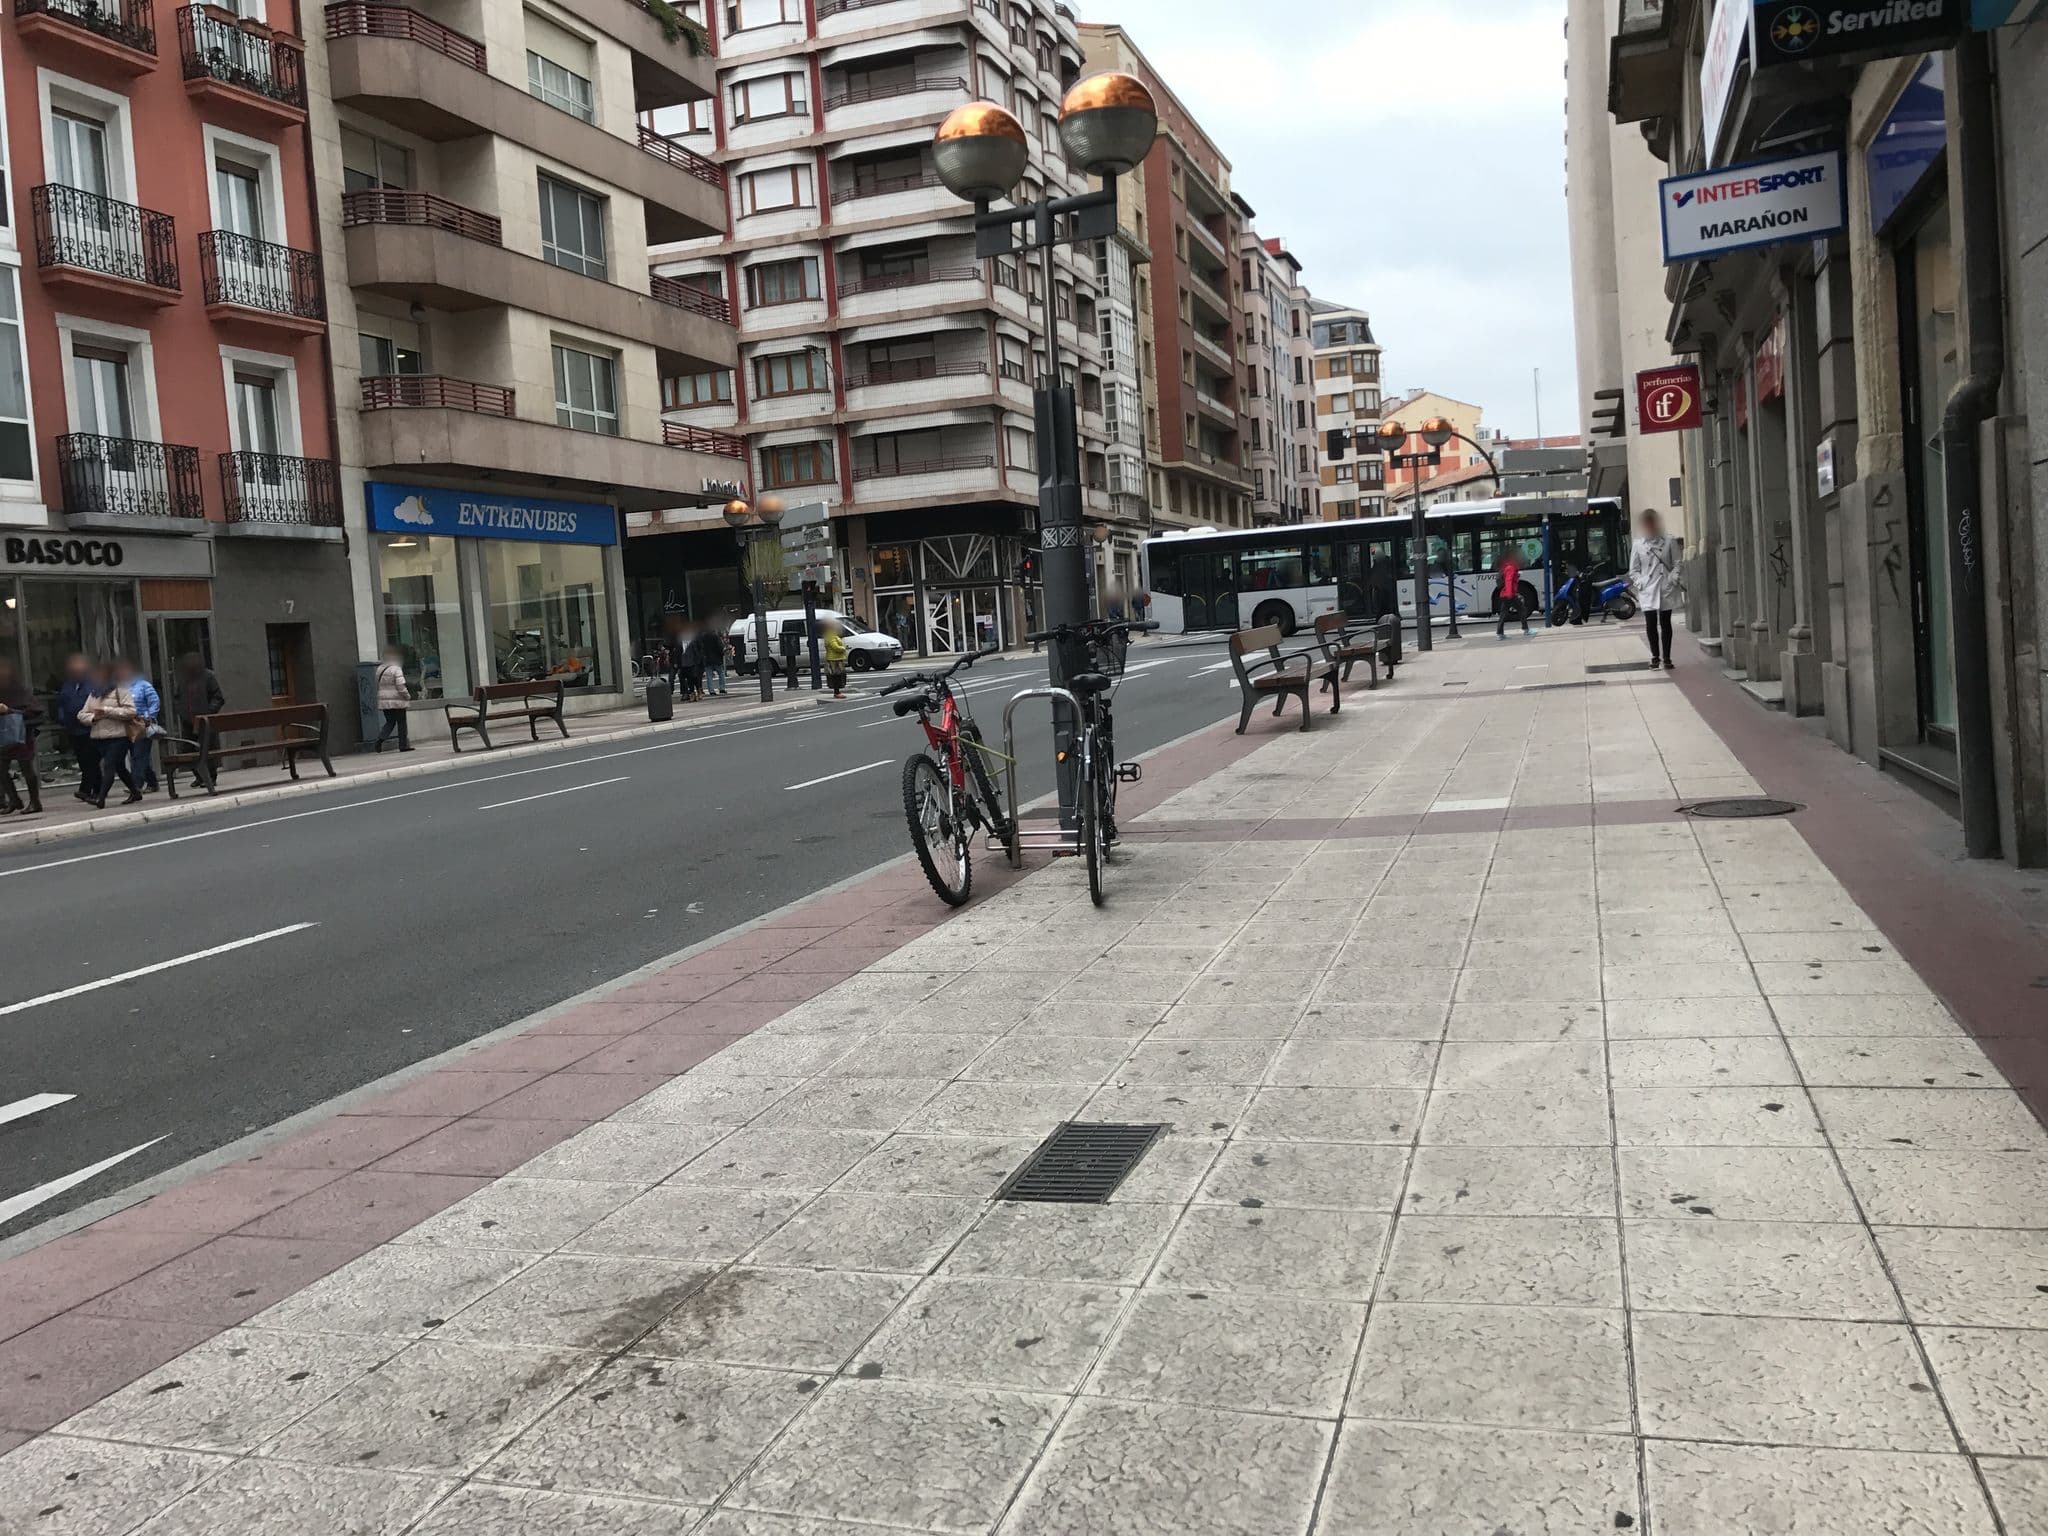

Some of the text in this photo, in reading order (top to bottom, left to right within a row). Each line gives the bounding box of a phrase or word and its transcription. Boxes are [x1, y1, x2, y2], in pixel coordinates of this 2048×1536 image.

[1827, 0, 1942, 34] ServiRed
[1697, 166, 1824, 204] INTERSPORT
[1701, 207, 1808, 239] MARAÑON
[1656, 392, 1674, 417] if
[458, 503, 577, 532] ENTRENUBES
[5, 538, 123, 566] BASOCO
